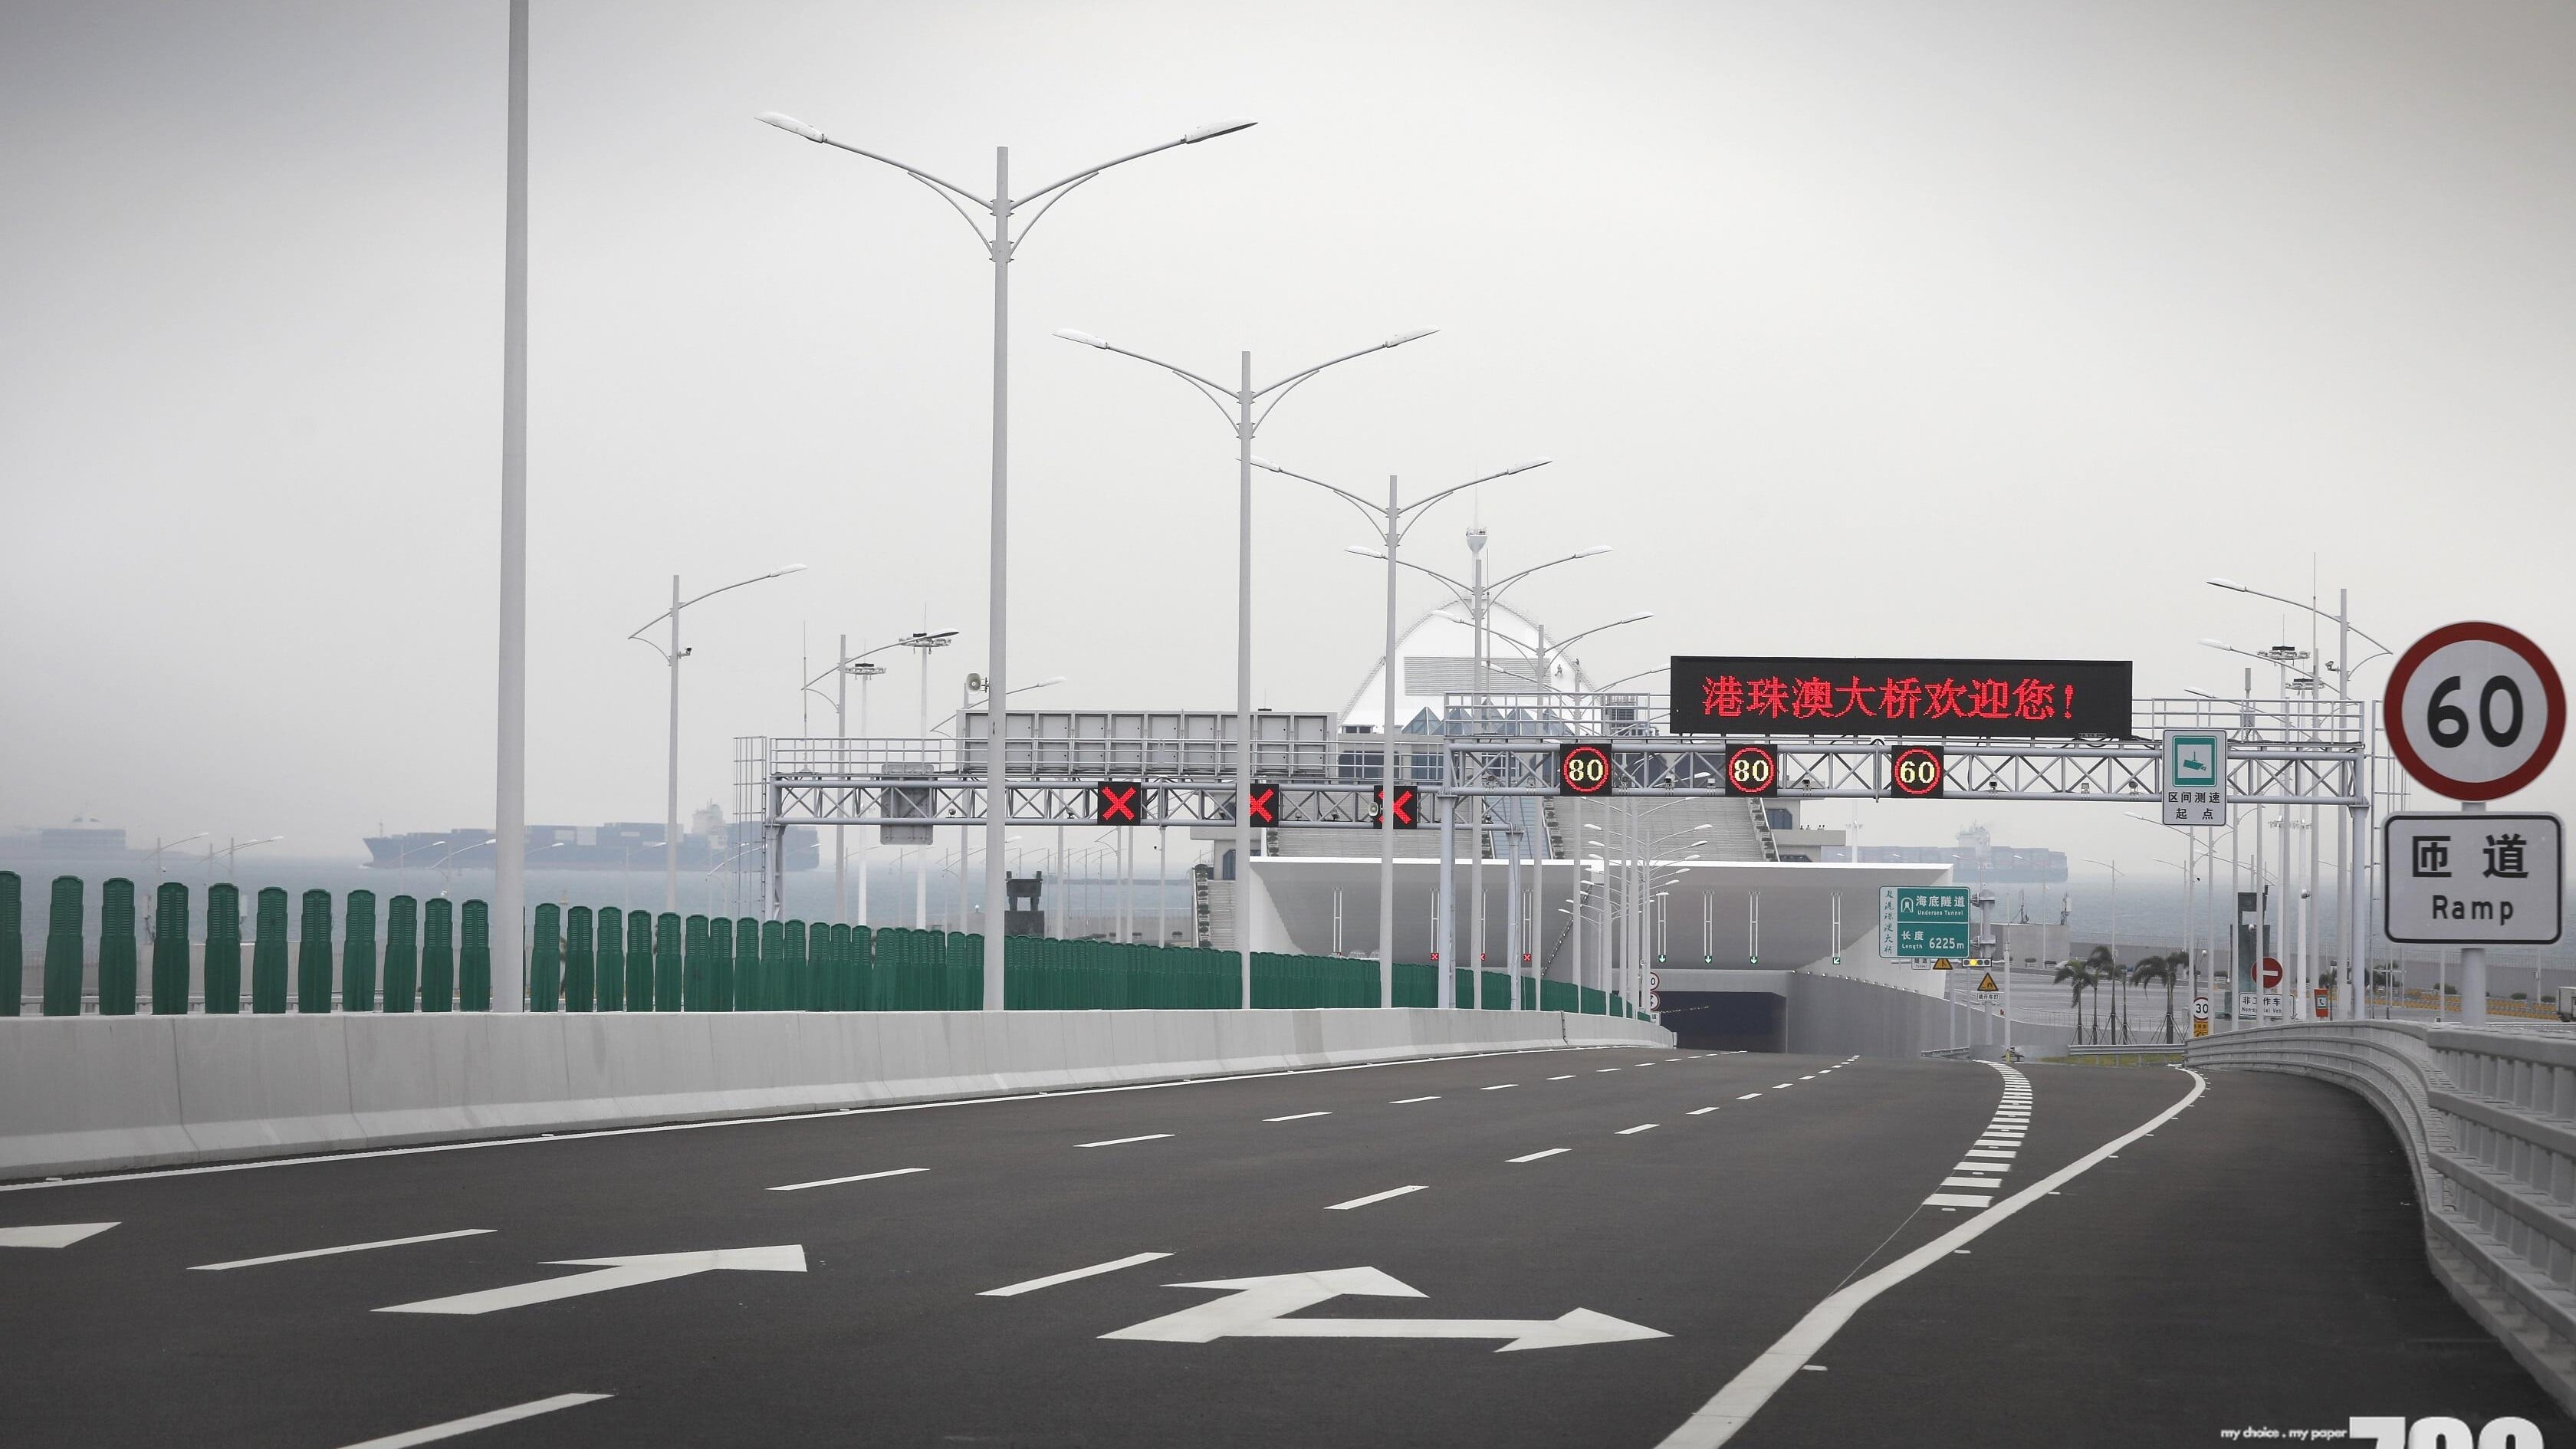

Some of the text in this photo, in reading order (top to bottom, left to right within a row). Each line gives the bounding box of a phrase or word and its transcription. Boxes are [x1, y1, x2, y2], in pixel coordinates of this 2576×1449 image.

[2427, 675, 2523, 748] 60
[1569, 759, 1603, 781] 80
[1733, 760, 1769, 782] 80
[1900, 761, 1935, 784] 60
[2168, 791, 2221, 803] 区间测速
[2176, 807, 2213, 820] 起点
[2412, 833, 2528, 879] 匝道
[1915, 895, 1966, 908] 海底隧道
[2432, 895, 2514, 925] Ramp
[1901, 930, 1924, 941] 长度
[2195, 1003, 2209, 1014] 30
